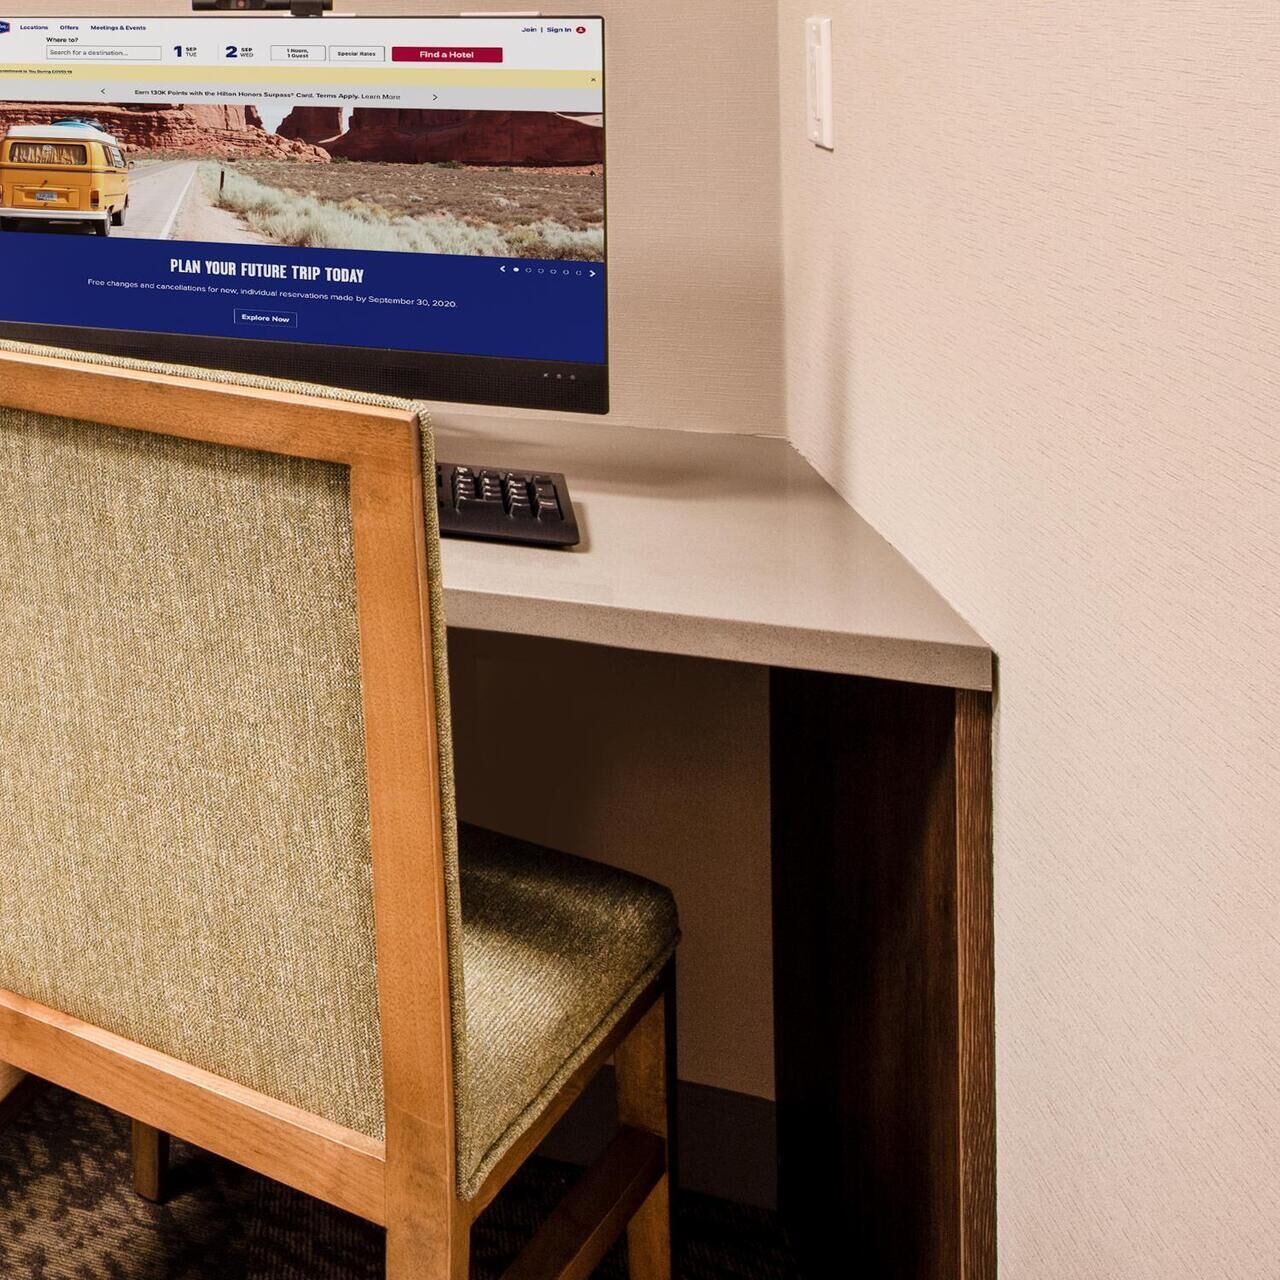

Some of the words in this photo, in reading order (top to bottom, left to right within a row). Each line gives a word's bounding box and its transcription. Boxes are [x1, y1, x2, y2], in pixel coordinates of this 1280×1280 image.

[173, 45, 182, 57] 1
[225, 46, 238, 58] 2
[170, 259, 200, 274] PLAN
[205, 260, 236, 276] YOUR
[241, 262, 287, 279] FUTURE
[291, 265, 321, 280] TRIP
[325, 267, 364, 283] TODAY
[87, 278, 105, 286] Free
[106, 280, 138, 289] changes
[156, 283, 206, 292] cancellations
[240, 288, 277, 297] individual
[279, 291, 329, 300] reservations
[356, 295, 367, 303] by
[368, 295, 415, 305] September
[416, 299, 430, 307] 30,
[432, 300, 458, 308] 2020.
[241, 314, 270, 322] Explore
[271, 315, 290, 323] Now
